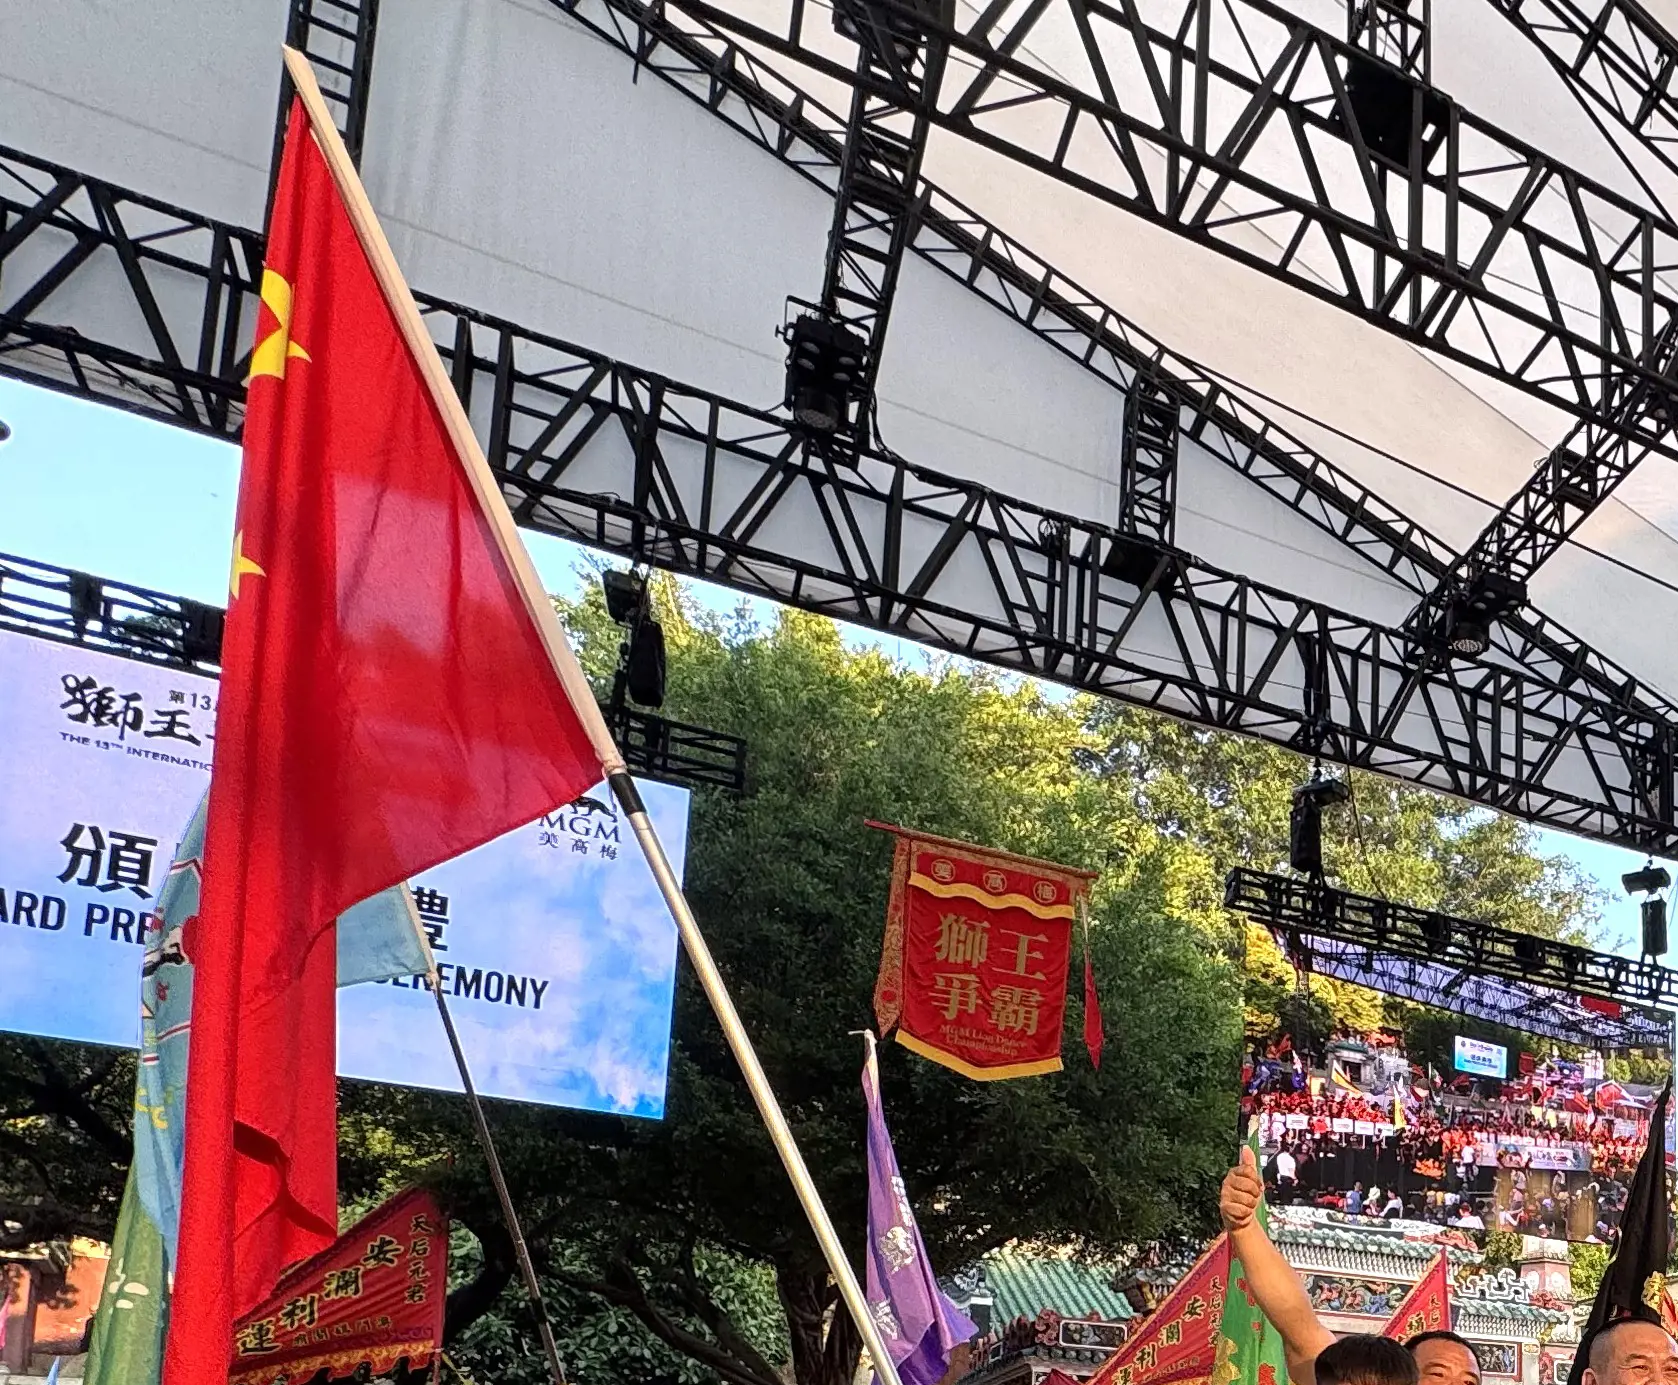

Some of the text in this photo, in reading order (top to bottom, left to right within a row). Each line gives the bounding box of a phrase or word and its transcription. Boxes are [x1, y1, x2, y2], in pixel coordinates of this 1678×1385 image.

[169, 690, 217, 711] 第13
[59, 731, 90, 746] THE
[538, 814, 622, 843] MGM
[538, 831, 618, 860] 美高梅
[933, 912, 1049, 981] 獅王
[928, 973, 1044, 1036] 爭霸
